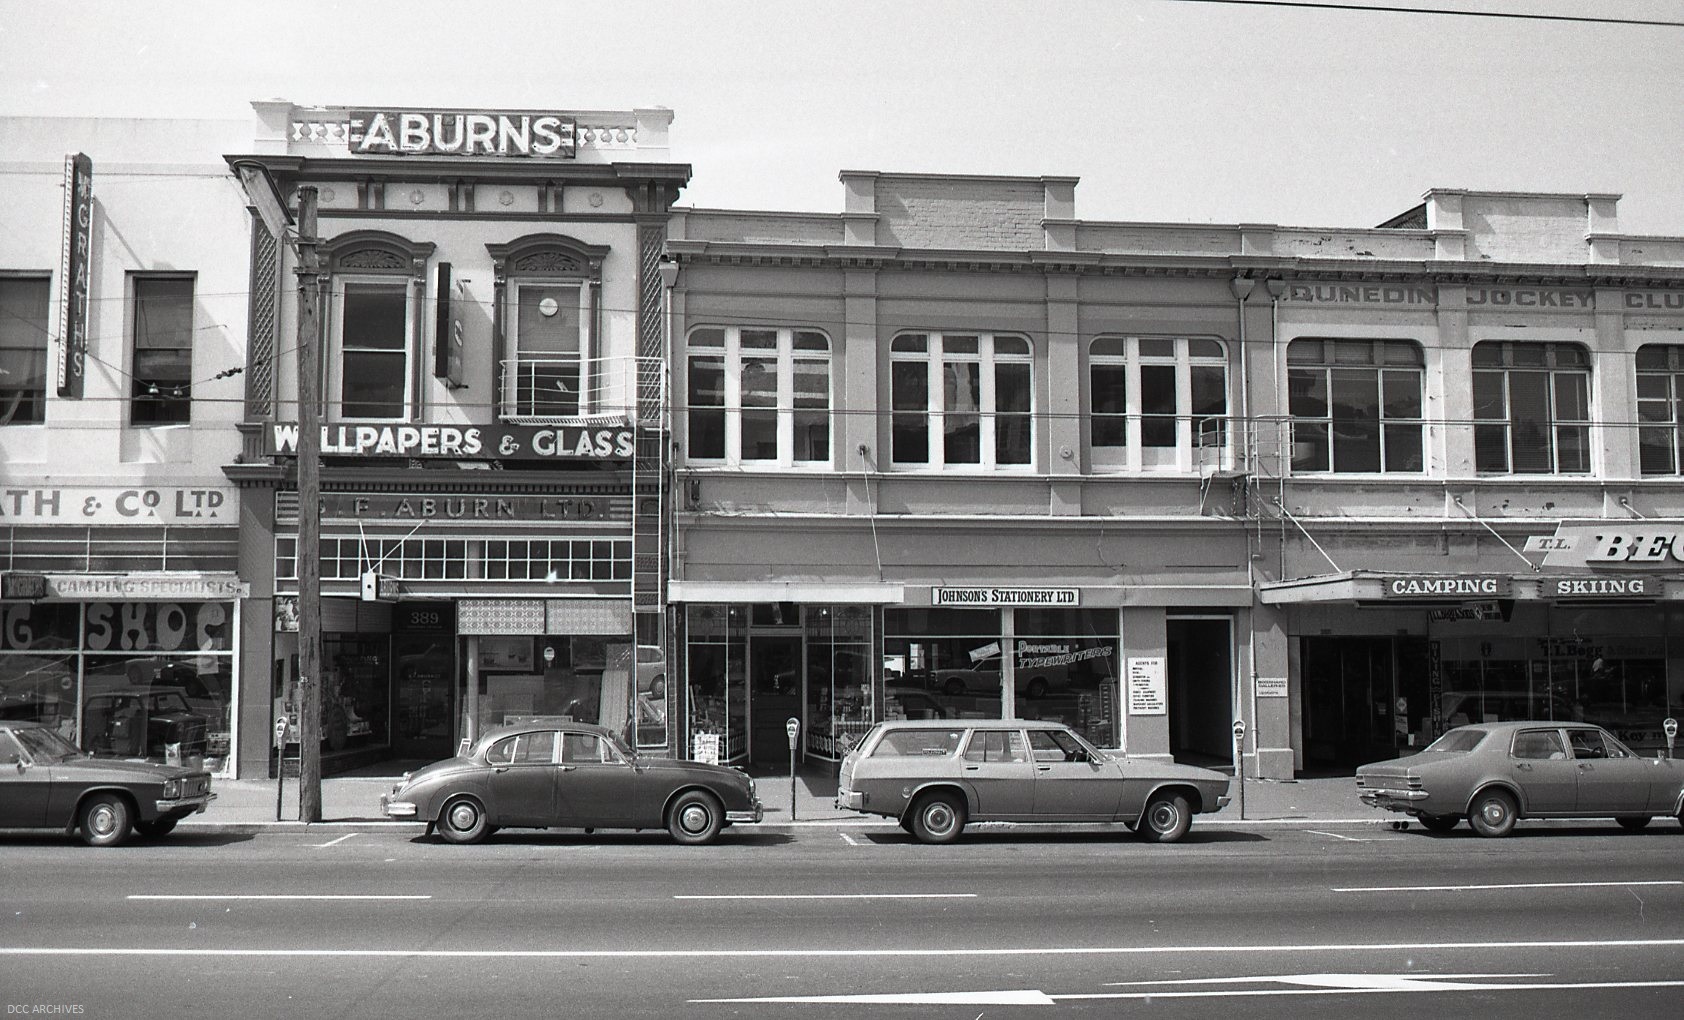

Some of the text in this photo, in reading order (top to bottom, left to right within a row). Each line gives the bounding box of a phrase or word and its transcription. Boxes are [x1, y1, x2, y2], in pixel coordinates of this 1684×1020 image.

[359, 112, 561, 154] ABURNS
[1289, 285, 1438, 303] DUNEDIN
[1466, 289, 1596, 308] JOCKEY
[273, 425, 634, 457] WLLPAPERS & GLASS
[82, 496, 102, 517] &
[394, 499, 516, 519] ABURN
[1539, 538, 1571, 549] T.L.
[57, 580, 135, 593] CAMPING
[937, 588, 1075, 604] JOHNSON'S STATIONERY LTD
[1392, 579, 1644, 594] CAMPING SKIING
[87, 602, 226, 650] SHOP
[410, 611, 439, 625] 389
[1019, 646, 1113, 670] TYPEWRITERS
